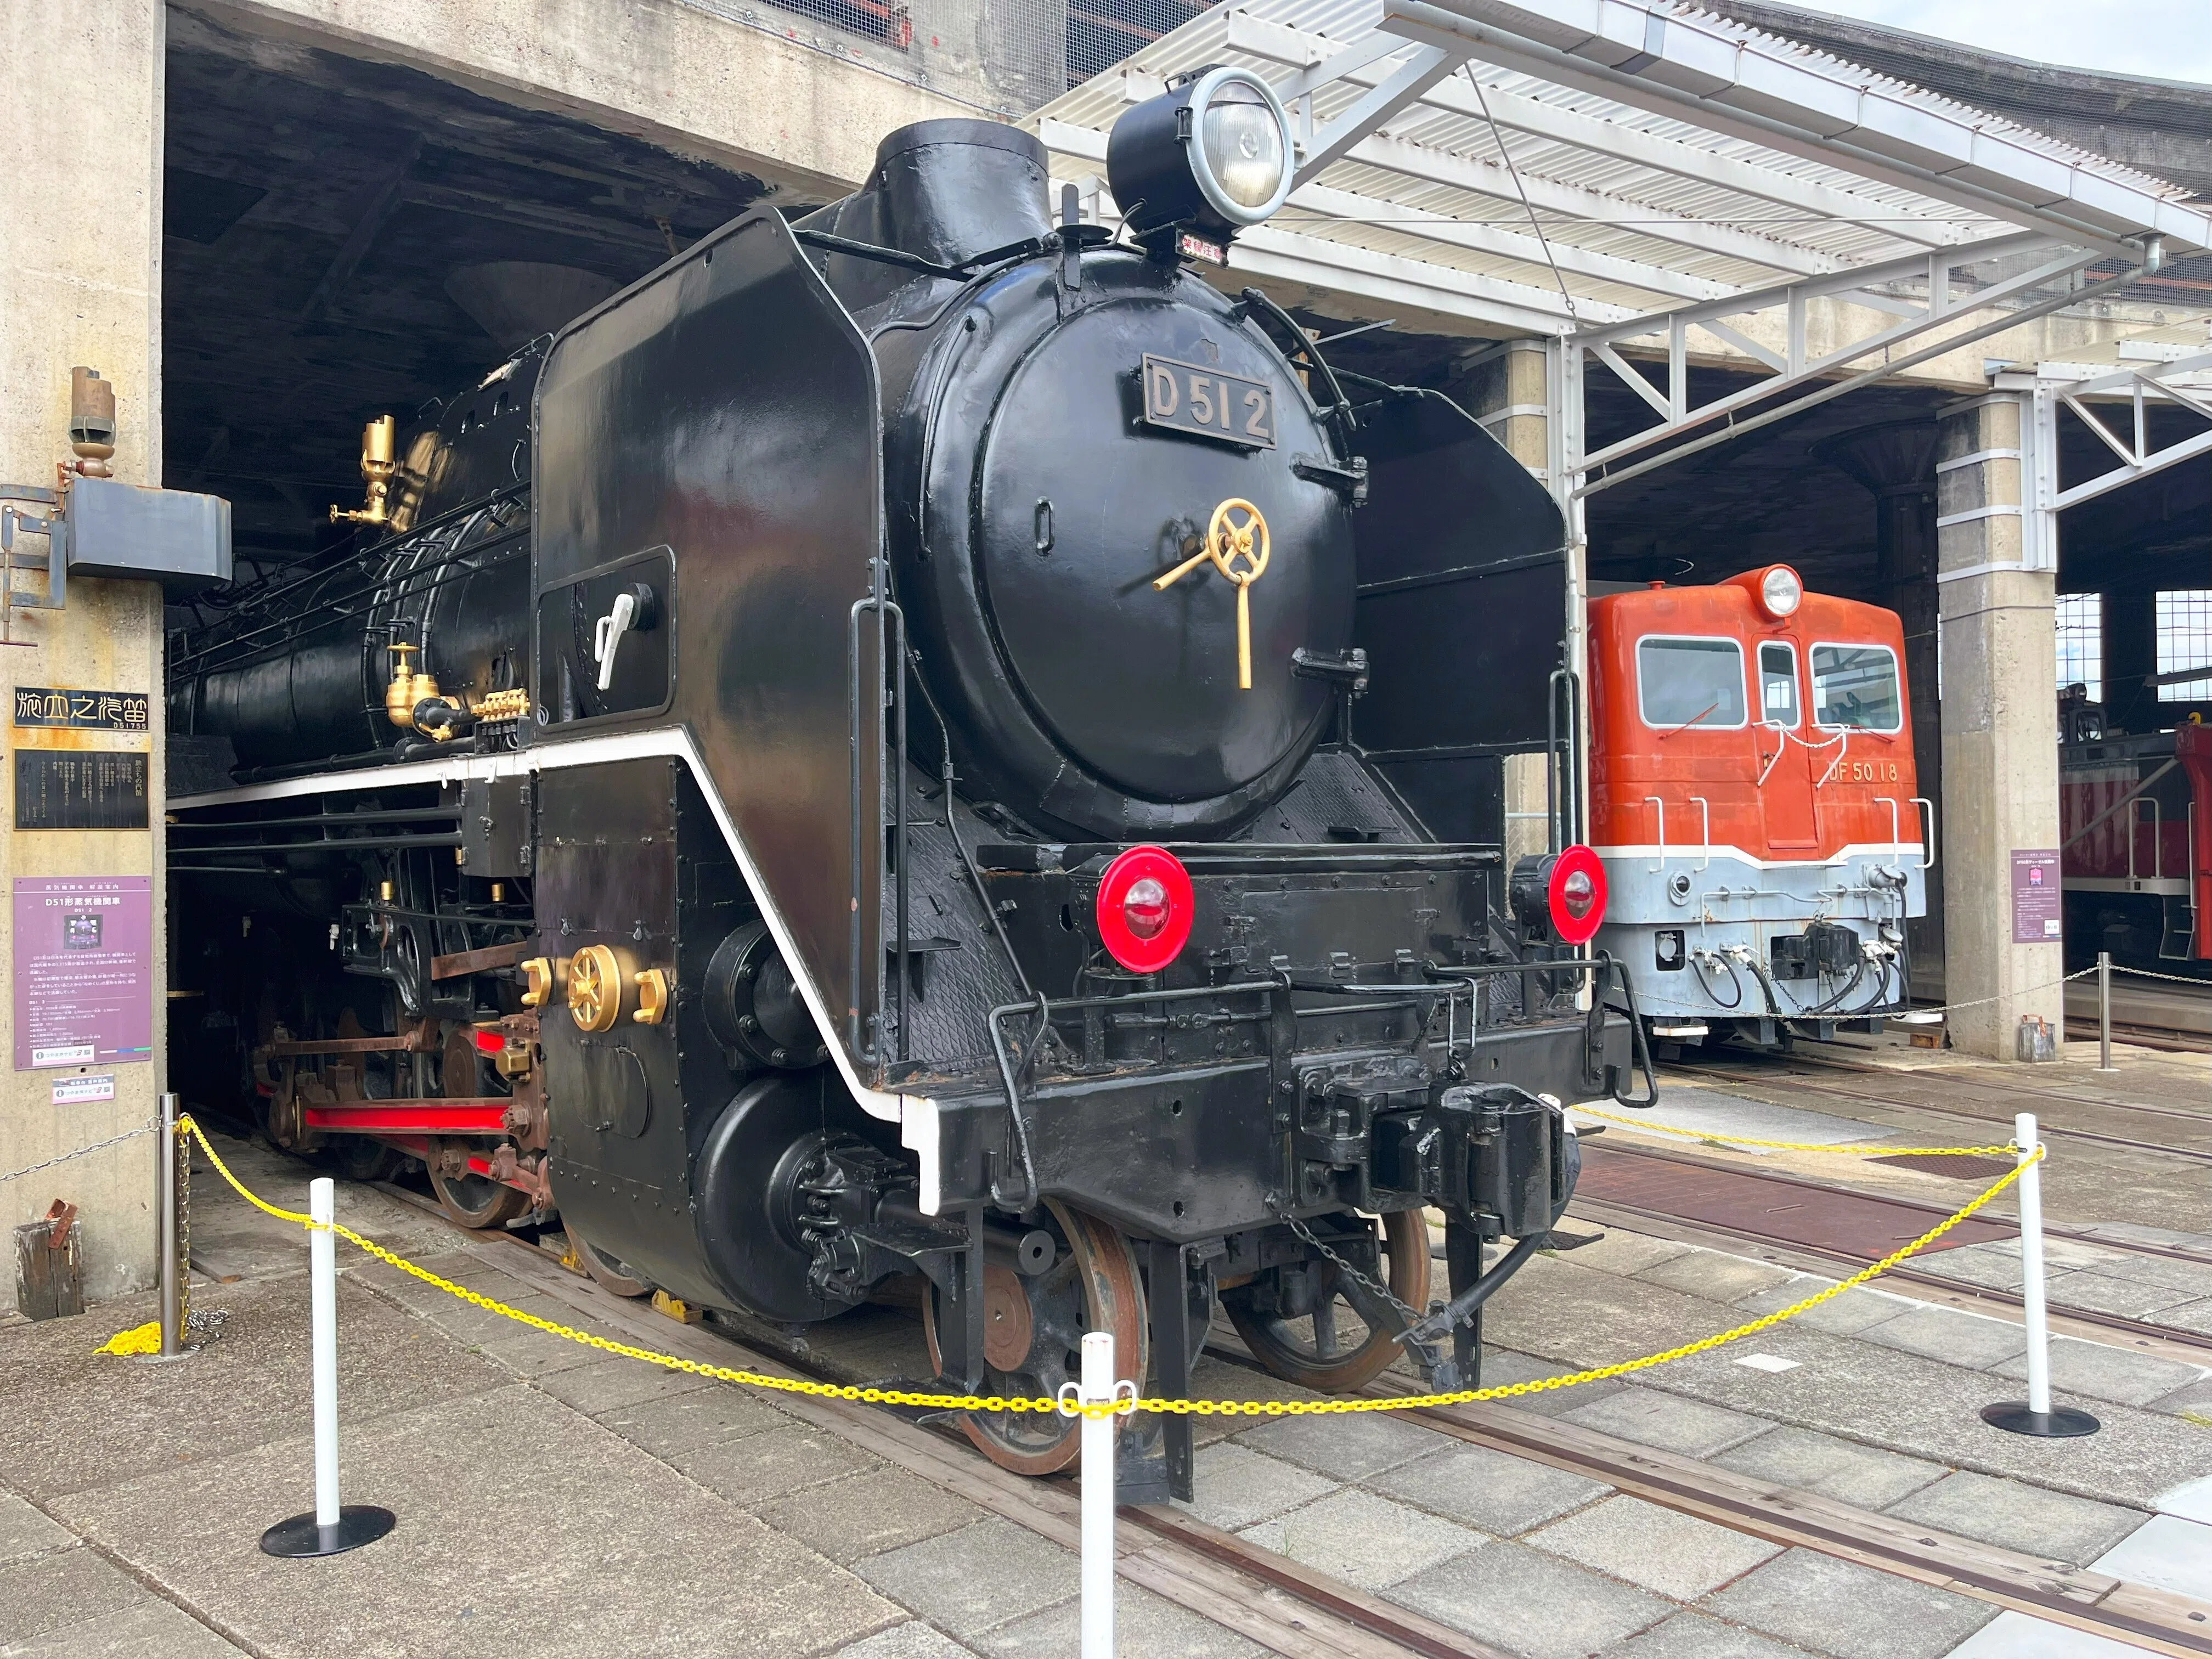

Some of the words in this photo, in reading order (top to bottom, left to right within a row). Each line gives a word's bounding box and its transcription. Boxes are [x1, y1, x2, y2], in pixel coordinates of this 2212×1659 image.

[1244, 389, 1269, 438] 2
[1853, 763, 1873, 782] 50
[1880, 763, 1898, 782] 18
[46, 897, 121, 906] D51形蒸気機関車
